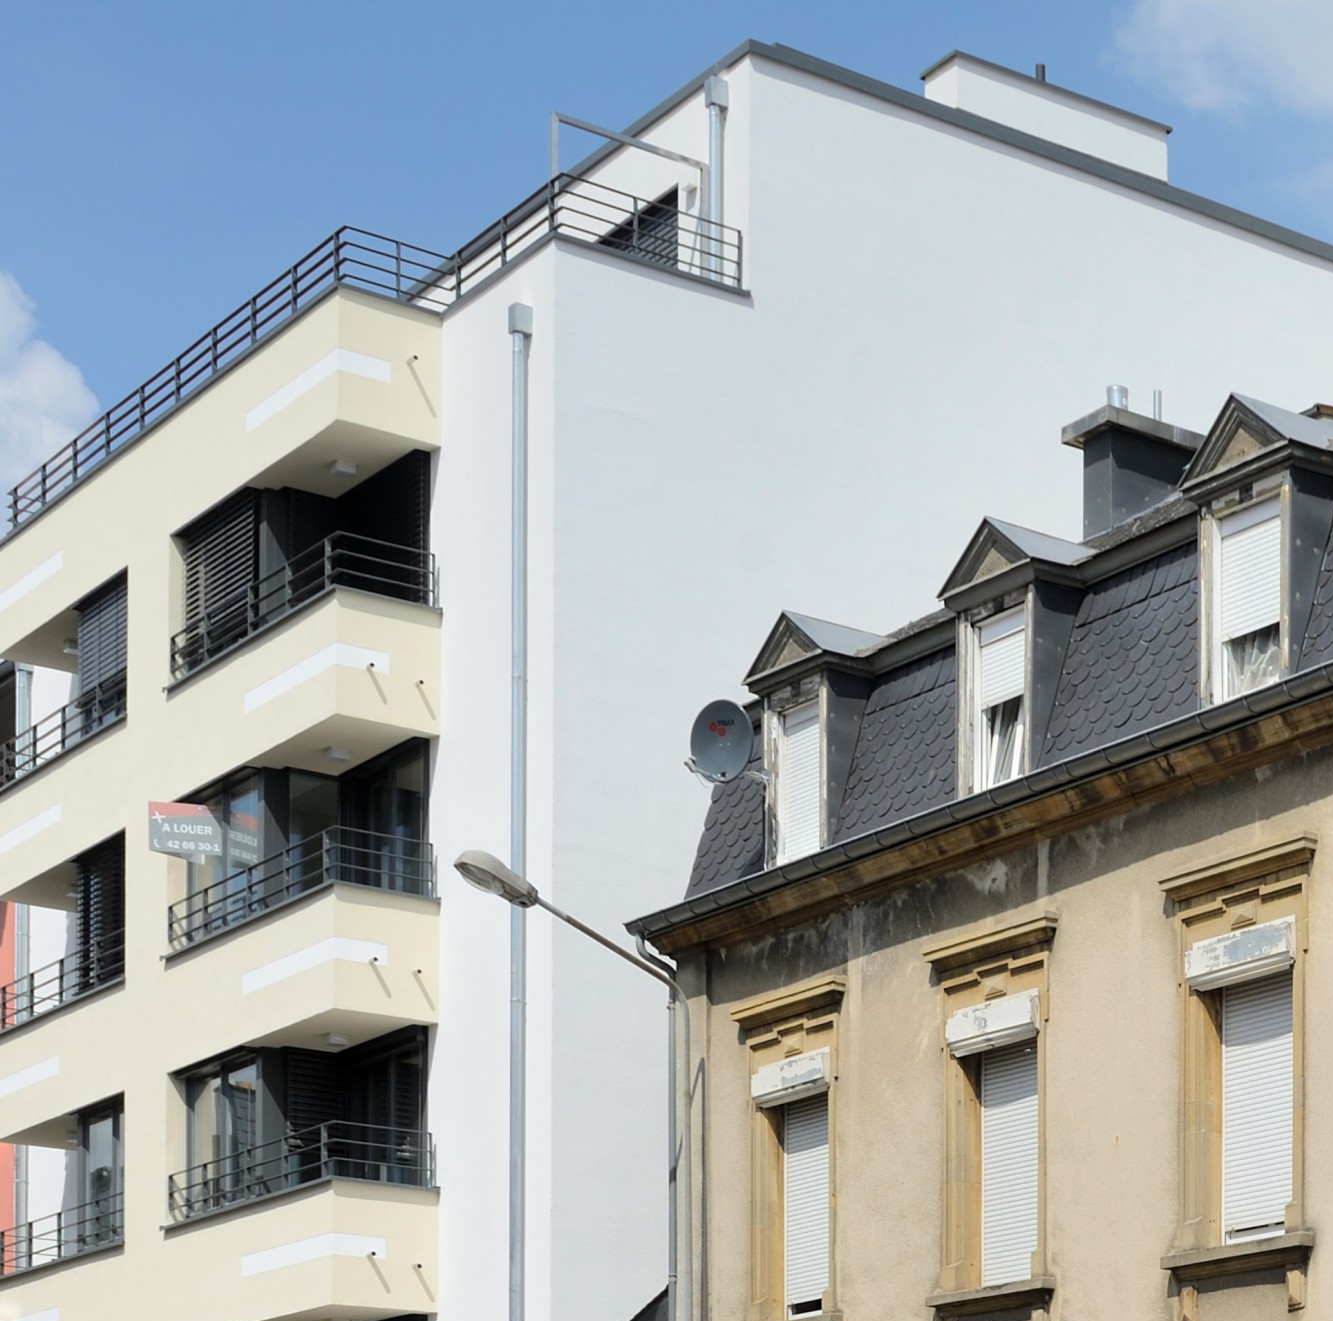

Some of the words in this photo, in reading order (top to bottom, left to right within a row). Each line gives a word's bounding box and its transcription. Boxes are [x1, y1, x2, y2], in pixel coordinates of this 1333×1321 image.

[162, 823, 171, 832] A
[174, 824, 213, 836] LOUER
[167, 840, 180, 849] 42
[182, 841, 195, 850] 66
